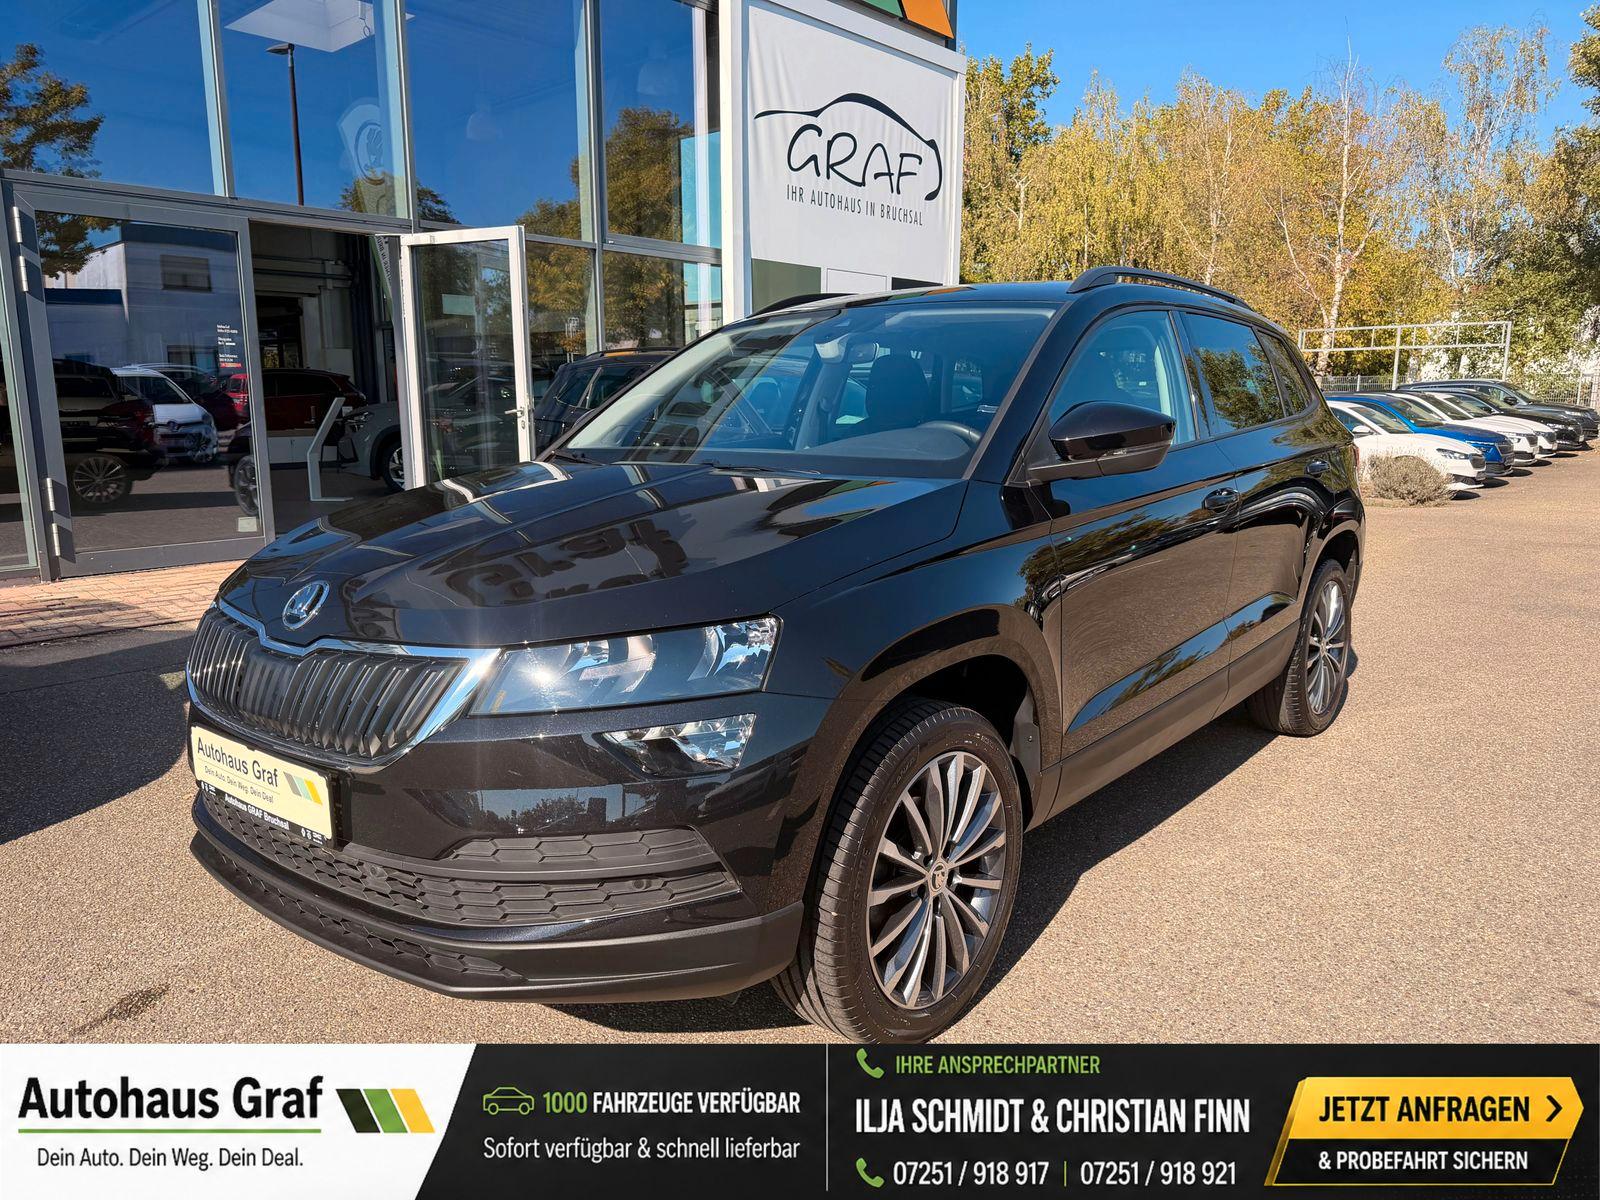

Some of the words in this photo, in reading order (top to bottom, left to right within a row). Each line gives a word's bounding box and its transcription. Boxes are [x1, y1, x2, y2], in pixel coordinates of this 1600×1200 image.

[787, 123, 923, 195] GRAF
[786, 184, 804, 203] IHR
[810, 190, 862, 214] AUTOHAUS
[866, 201, 875, 217] IN
[880, 203, 923, 226] BRUCHSAL
[197, 736, 249, 775] Autohaus
[252, 760, 278, 787] Graf
[248, 804, 263, 818] GRAF
[263, 811, 290, 830] Bruchsal
